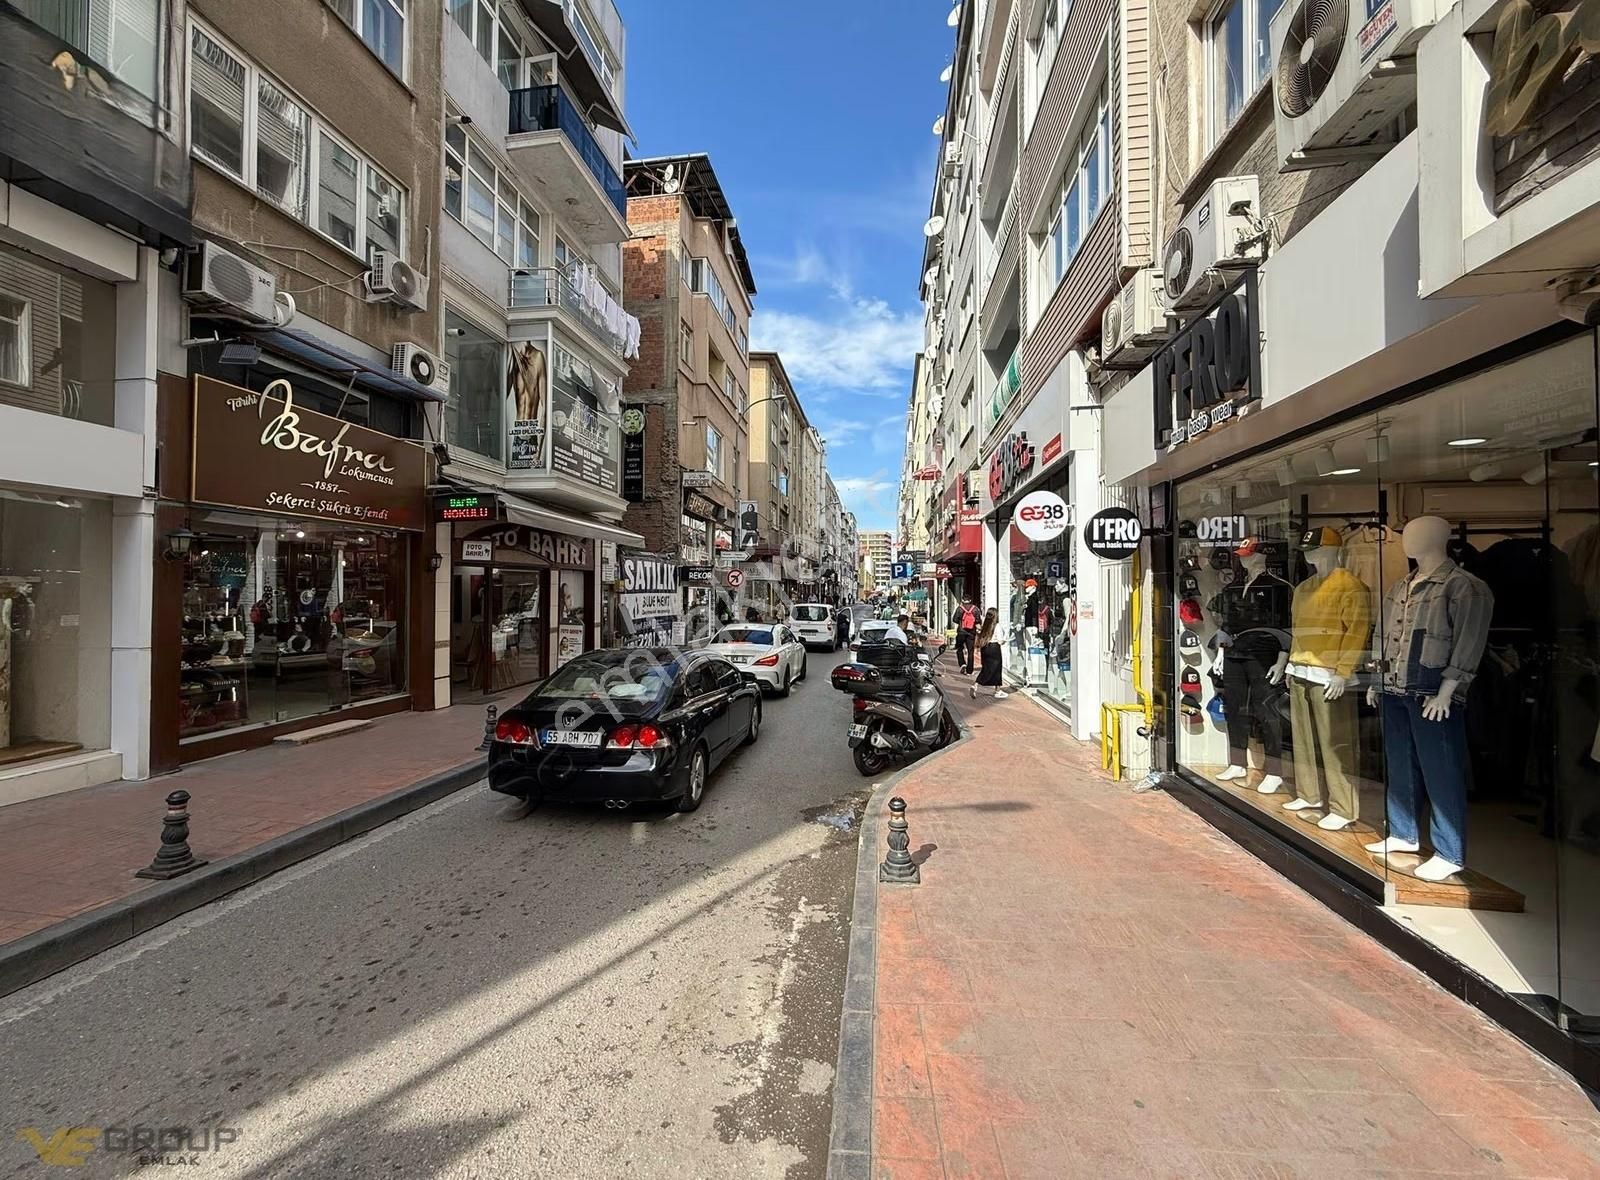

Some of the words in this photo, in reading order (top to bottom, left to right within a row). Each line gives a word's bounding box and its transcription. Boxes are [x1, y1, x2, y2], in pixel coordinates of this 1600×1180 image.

[259, 378, 395, 479] Bafra
[1171, 427, 1184, 445] man
[1188, 411, 1208, 436] basic
[1211, 399, 1233, 424] wear
[314, 480, 339, 493] 1887
[339, 465, 395, 486] Lokumcusu
[266, 491, 316, 509] Şekerci
[317, 500, 351, 516] Şükrü
[353, 506, 389, 521] Efendi
[1093, 518, 1141, 541] I'FRO
[624, 560, 675, 591] SATILIK
[688, 571, 713, 580] REKOR
[894, 566, 904, 577] P
[547, 731, 558, 743] 55
[583, 733, 599, 744] 707
